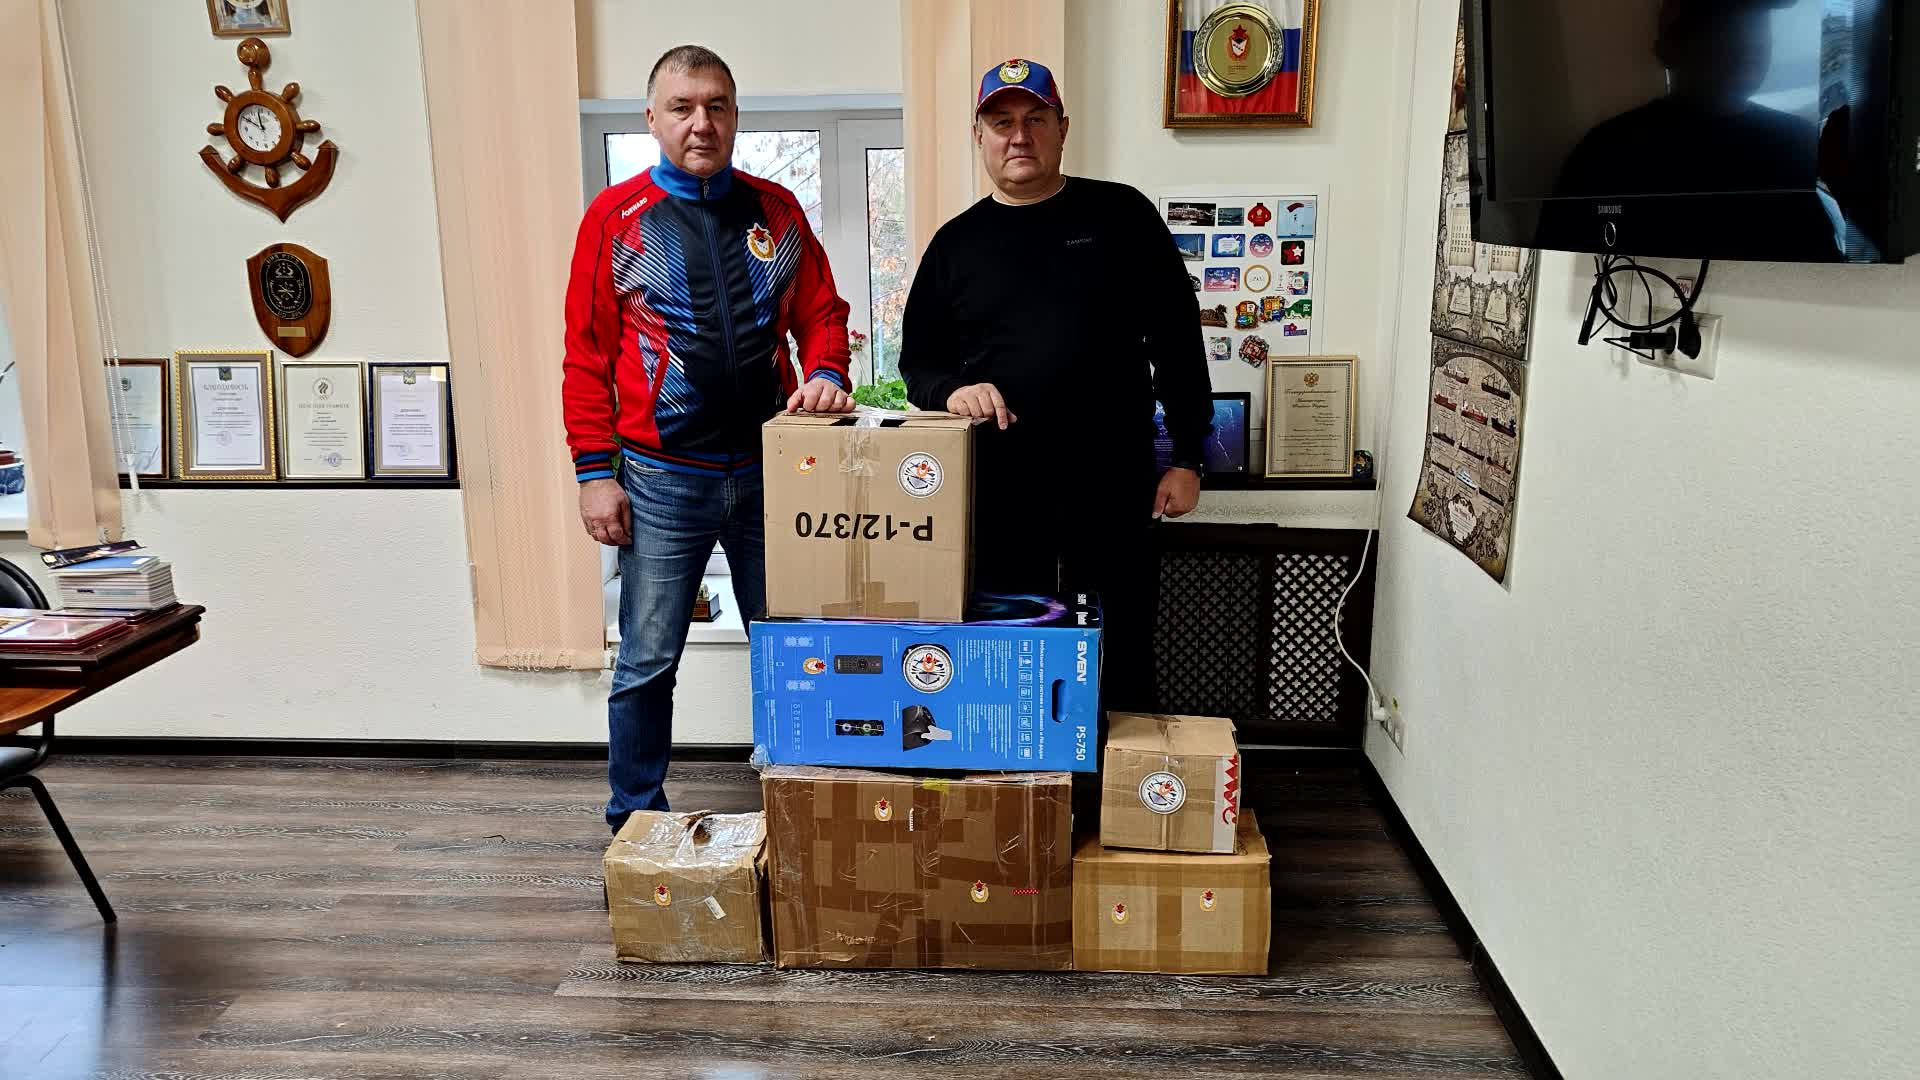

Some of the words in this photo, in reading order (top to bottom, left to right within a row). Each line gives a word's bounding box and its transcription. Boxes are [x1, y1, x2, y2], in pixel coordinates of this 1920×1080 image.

[795, 511, 933, 542] P-12/370
[1076, 640, 1088, 682] SVEN
[1076, 725, 1087, 761] PS-750
